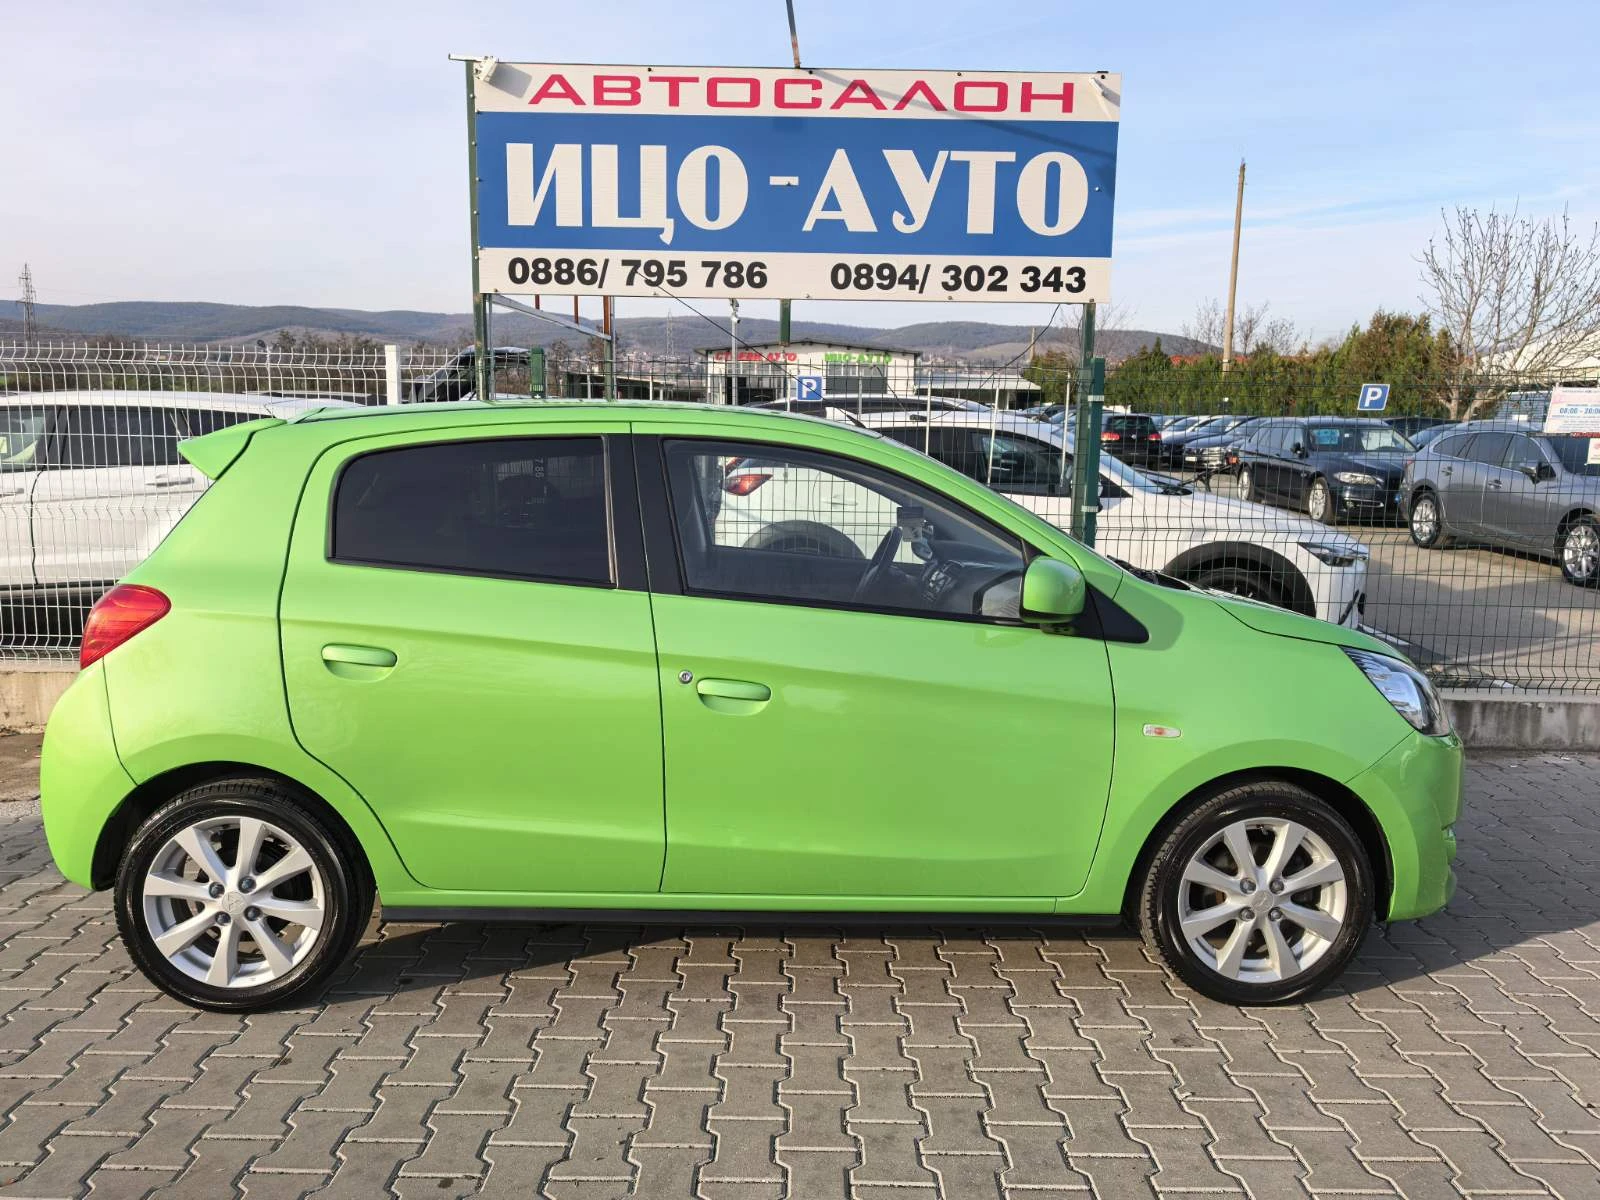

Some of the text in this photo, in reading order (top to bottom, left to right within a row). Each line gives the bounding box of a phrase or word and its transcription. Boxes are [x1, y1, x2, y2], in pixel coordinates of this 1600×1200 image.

[529, 74, 1075, 114] АВТОСАЛОН
[505, 142, 749, 245] ИЦО
[508, 257, 768, 289] 0886/ 795 786
[830, 262, 1086, 294] 0894/ 302 343
[801, 379, 817, 398] P
[1364, 387, 1383, 407] P
